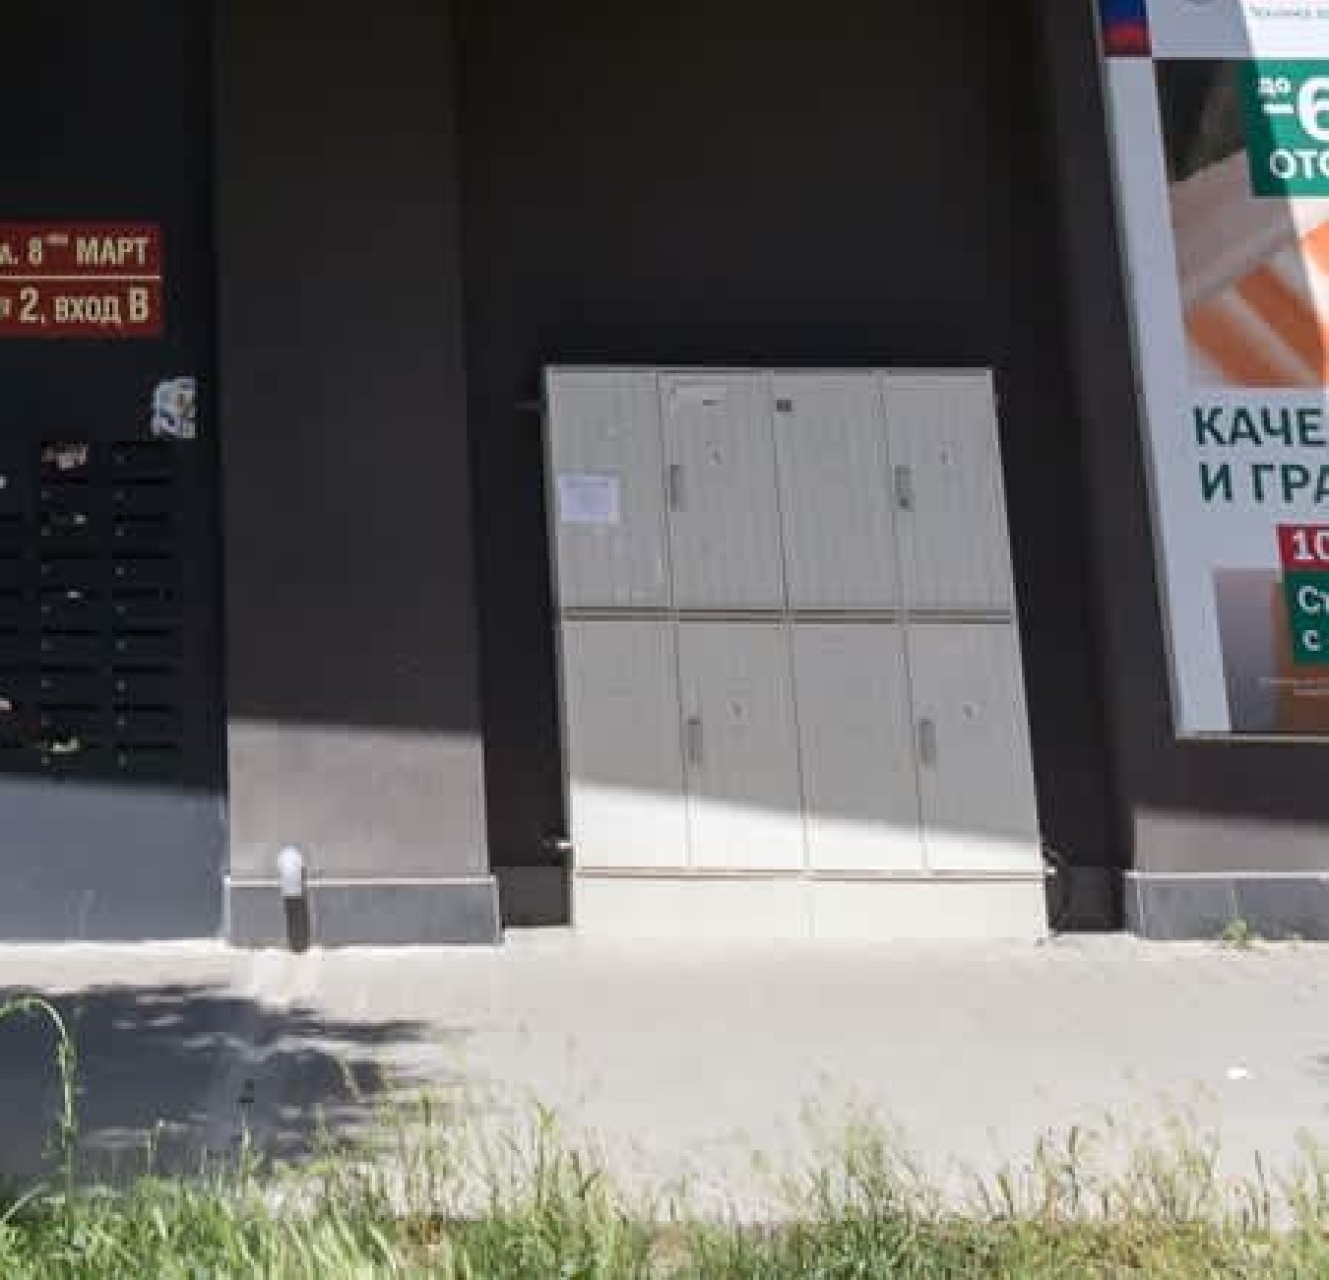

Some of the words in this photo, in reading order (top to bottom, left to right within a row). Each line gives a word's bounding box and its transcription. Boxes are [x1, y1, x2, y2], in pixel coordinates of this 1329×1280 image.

[76, 237, 149, 266] МАРТ
[20, 287, 47, 326] 2,
[129, 287, 149, 323] В
[1193, 406, 1326, 447] КАЧЕ
[1199, 463, 1233, 503] И
